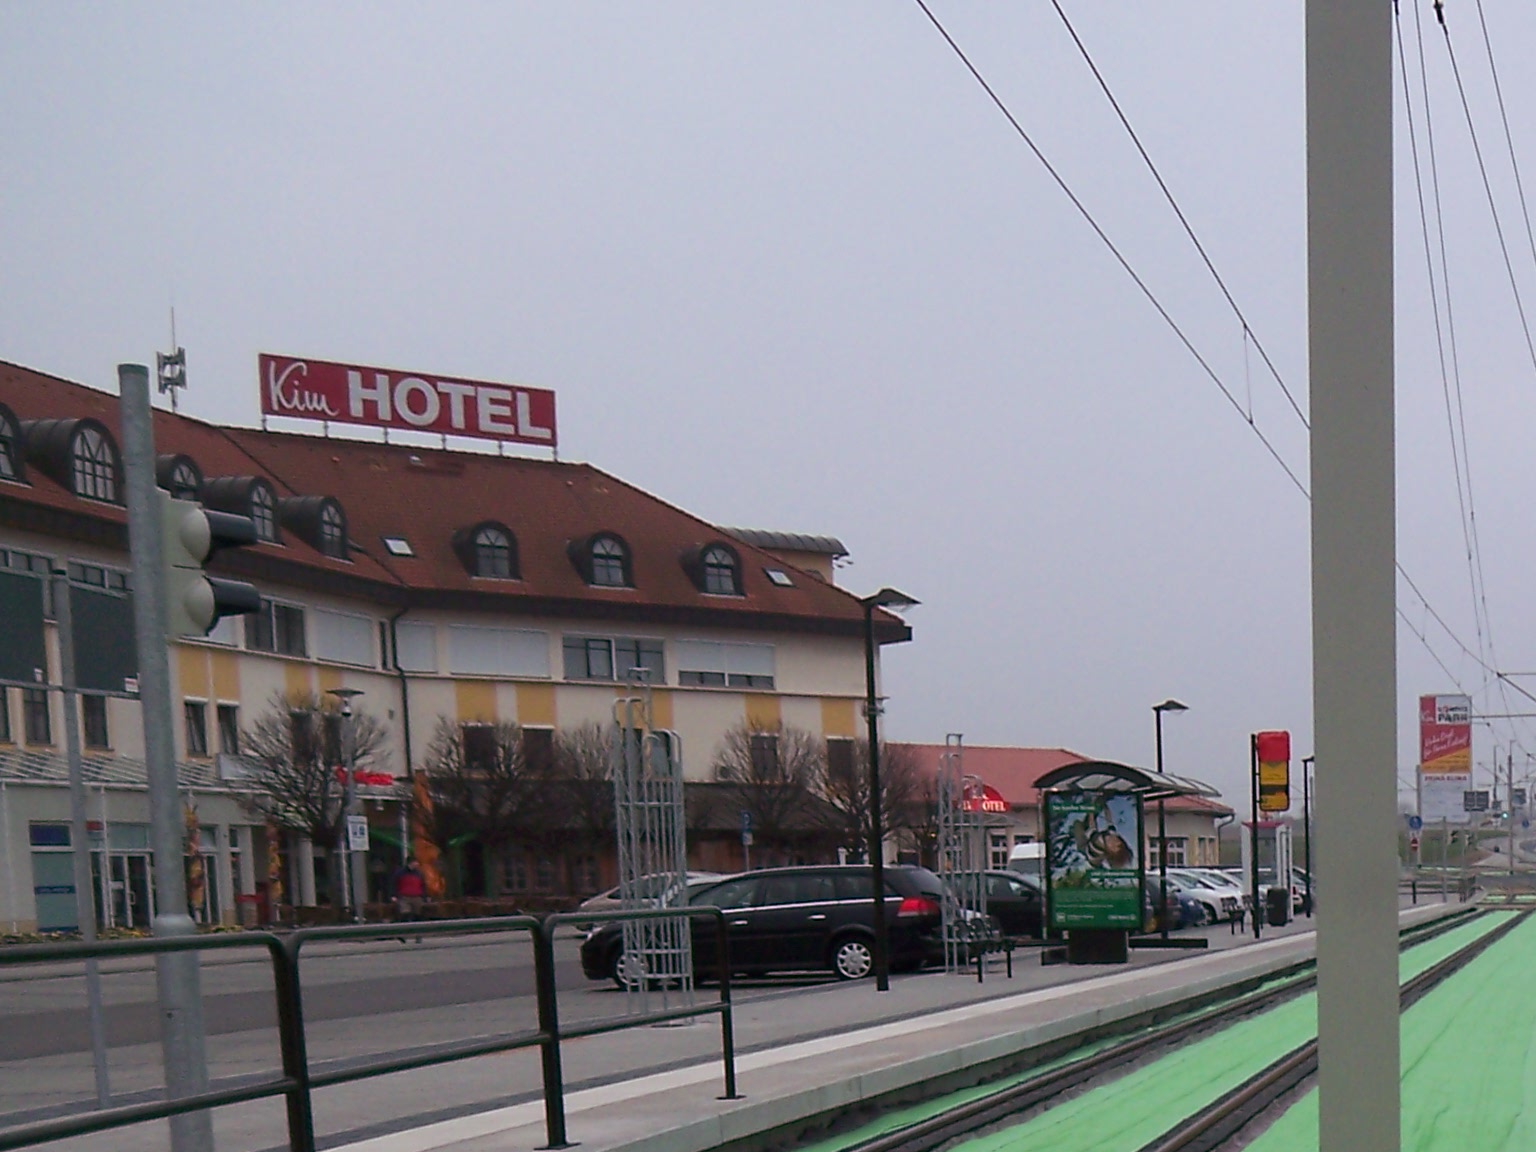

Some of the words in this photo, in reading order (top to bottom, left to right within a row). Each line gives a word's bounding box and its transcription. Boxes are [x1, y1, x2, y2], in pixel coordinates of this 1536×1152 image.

[268, 361, 340, 417] Kim
[347, 370, 552, 440] HOTEL
[979, 799, 1007, 812] OTEL
